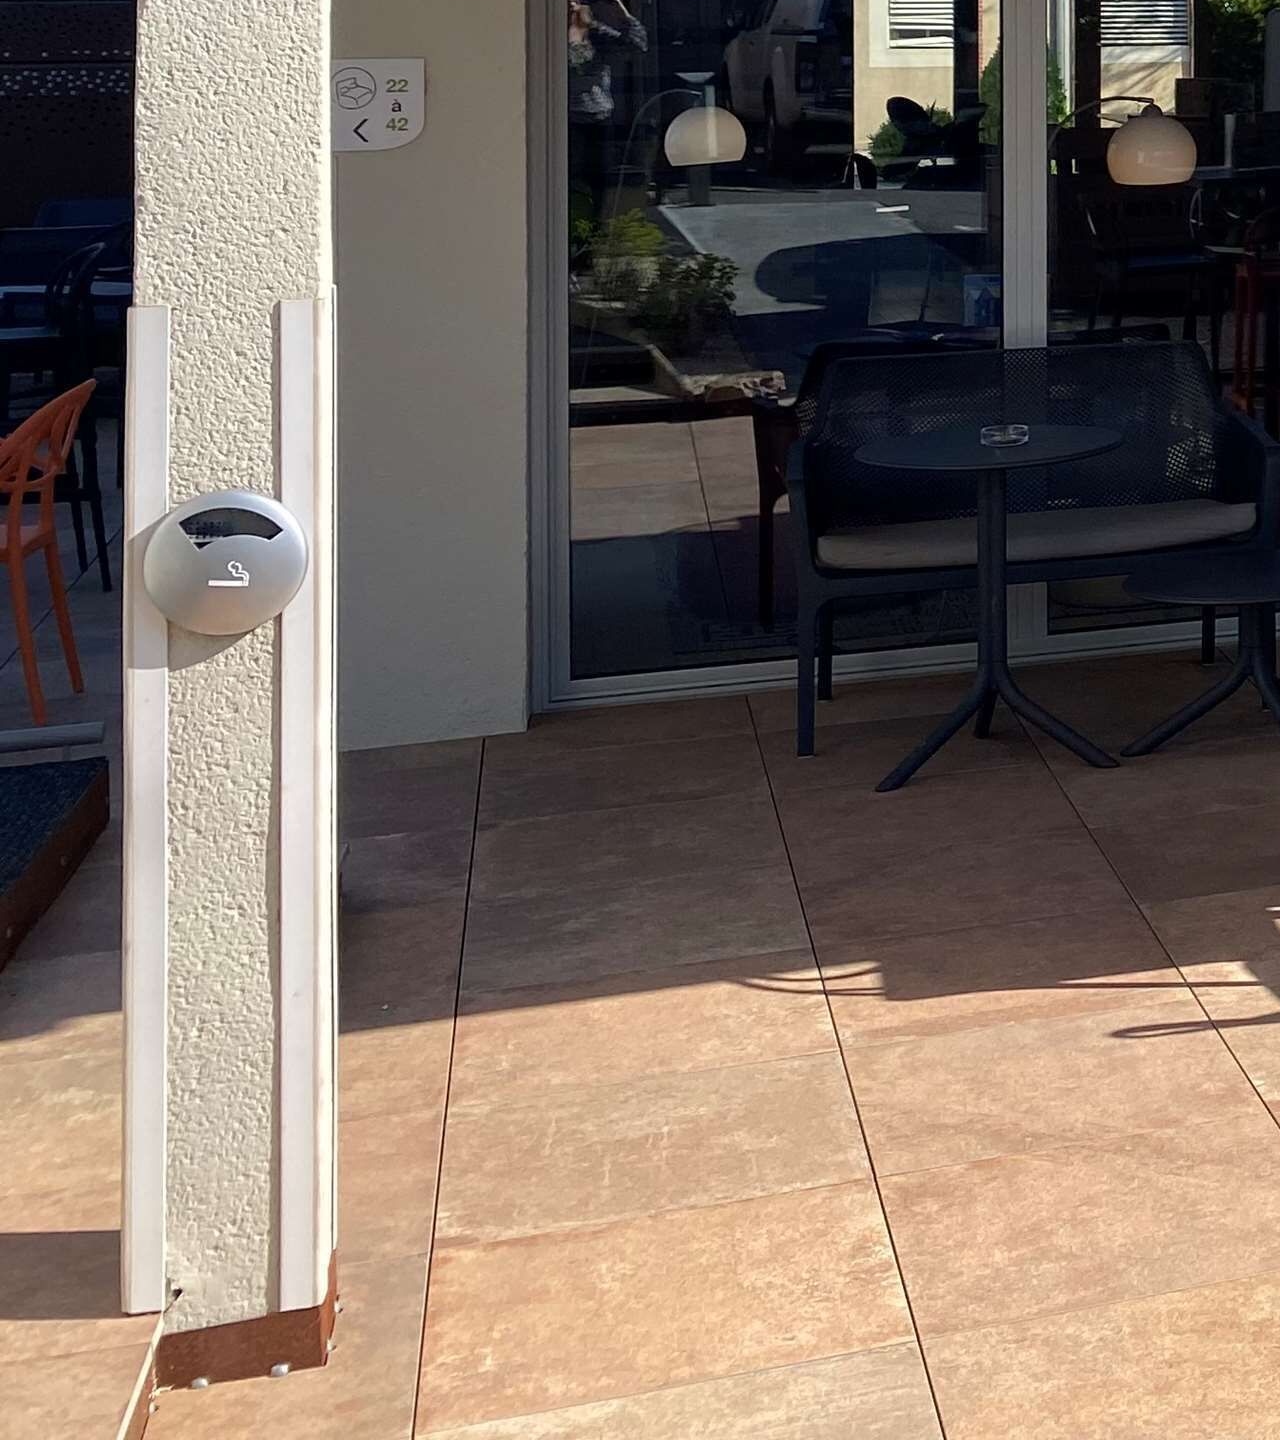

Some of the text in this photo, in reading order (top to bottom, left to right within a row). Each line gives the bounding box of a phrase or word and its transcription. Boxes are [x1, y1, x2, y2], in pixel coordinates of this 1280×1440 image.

[385, 79, 409, 93] 22
[391, 99, 402, 112] à
[385, 117, 409, 131] 42
